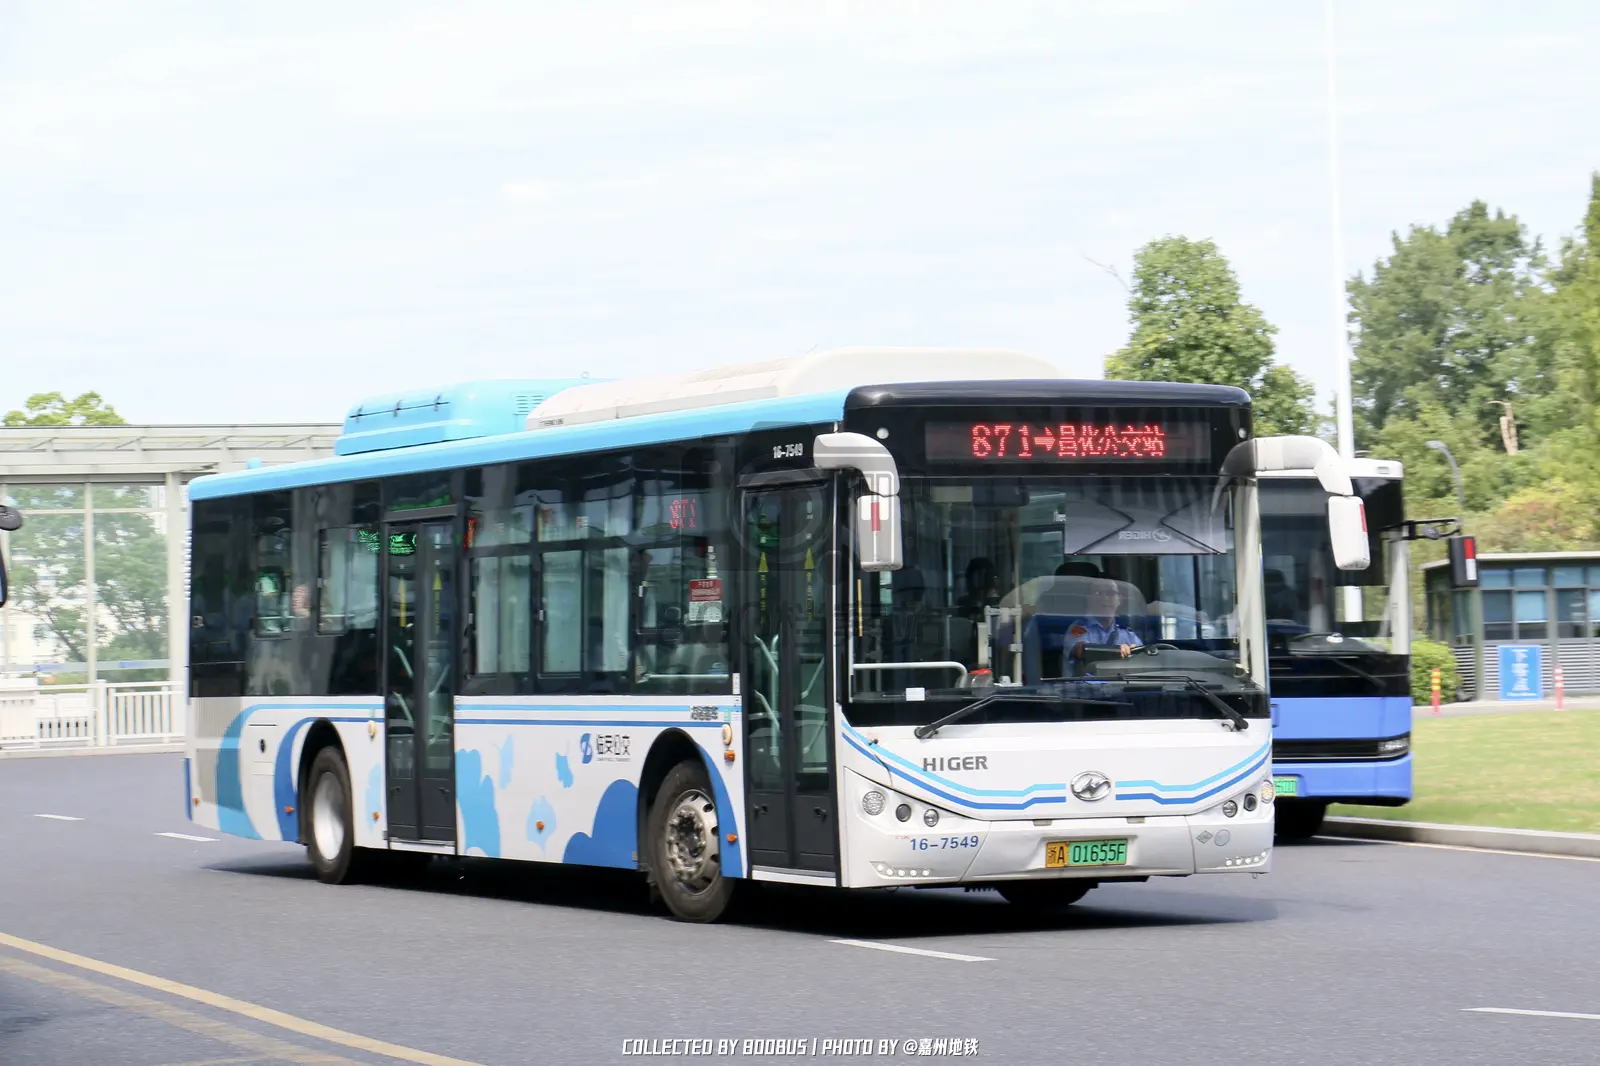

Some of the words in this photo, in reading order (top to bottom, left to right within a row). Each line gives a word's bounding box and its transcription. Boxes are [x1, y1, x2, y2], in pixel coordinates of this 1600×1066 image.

[971, 425, 1032, 457] 871
[1058, 424, 1165, 457] 昌化公交站
[772, 443, 804, 459] 16-7549
[595, 733, 631, 756] 临安公交
[922, 755, 989, 772] HIGER
[909, 835, 979, 851] 16-7549
[1072, 843, 1126, 863] 01655F
